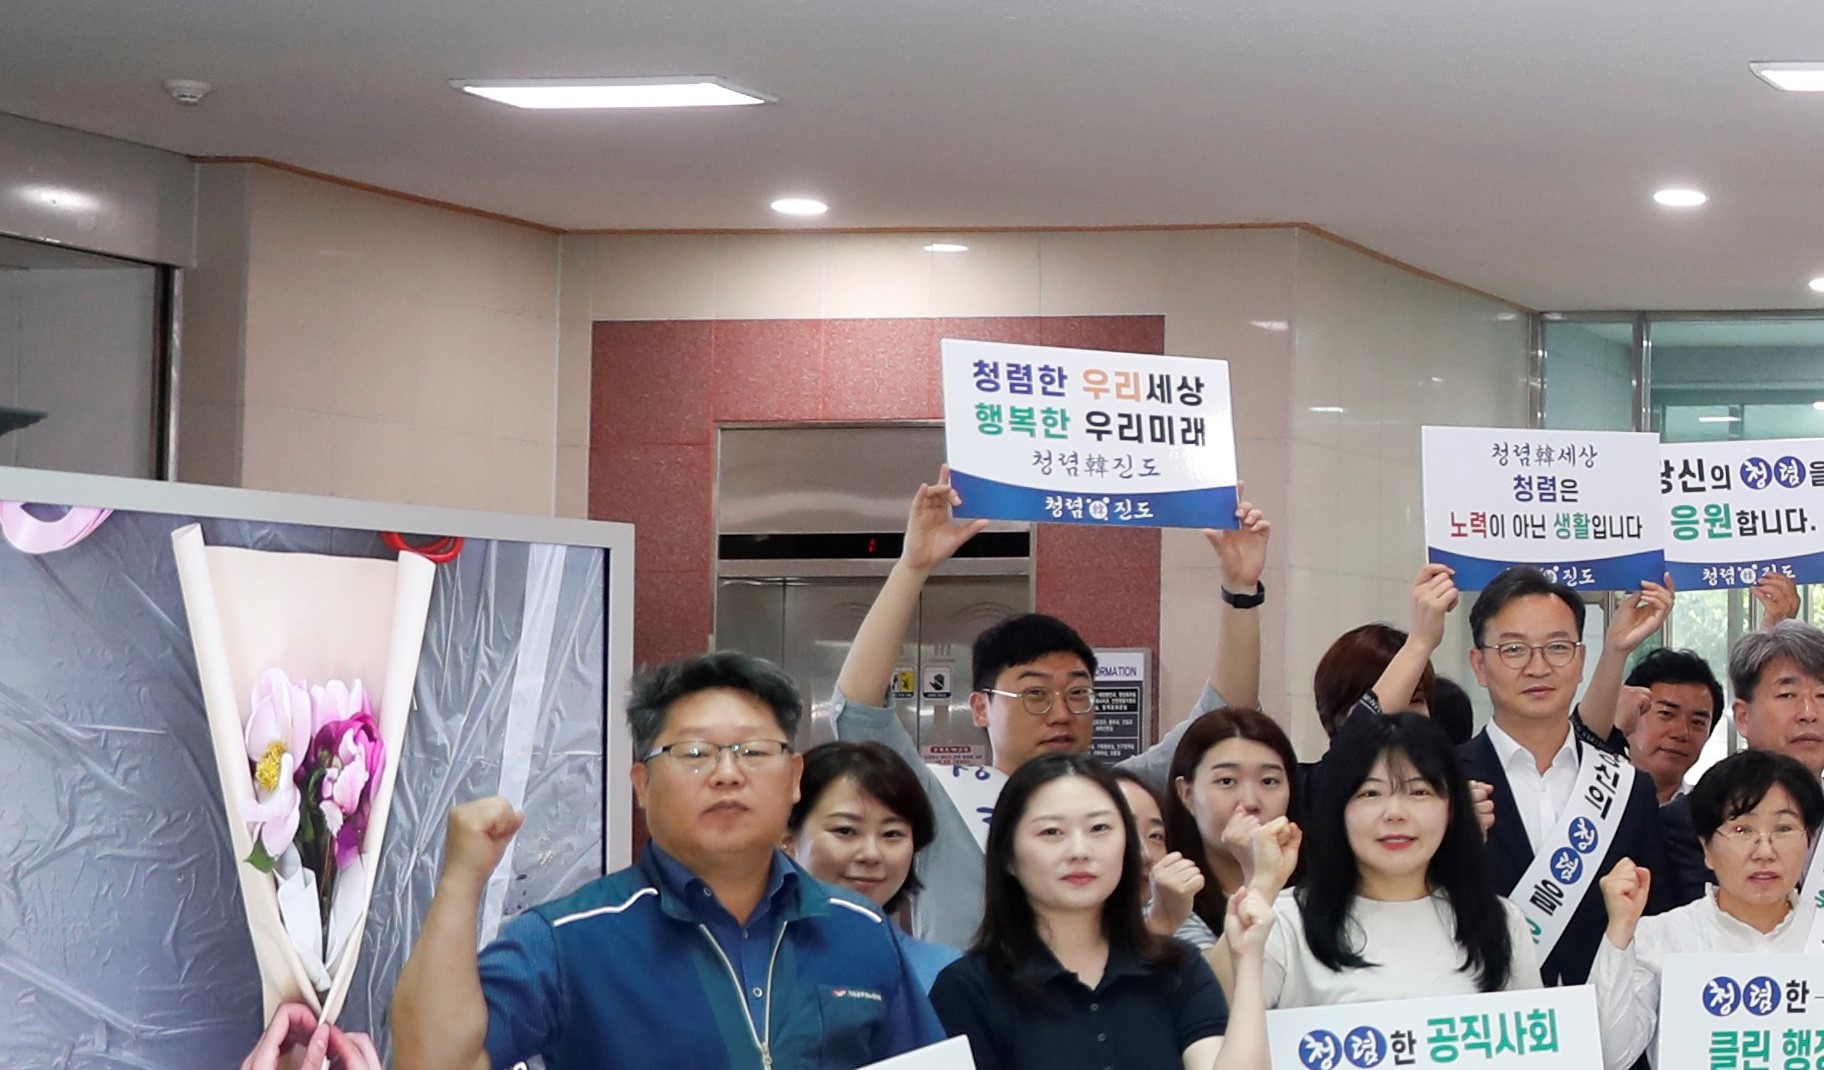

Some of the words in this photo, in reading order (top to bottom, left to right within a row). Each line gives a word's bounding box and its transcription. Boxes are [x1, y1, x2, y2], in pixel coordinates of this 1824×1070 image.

[973, 359, 1068, 397] 청렴한
[1082, 367, 1205, 407] 우리세상
[974, 402, 1070, 440] 행복한
[1085, 410, 1206, 447] 우리미래
[1512, 474, 1580, 503] 청렴은
[1450, 510, 1505, 540] 노력이
[1513, 512, 1546, 540] 아닌
[1553, 511, 1643, 541] 생활입니다
[1670, 503, 1817, 541] 응원합니다.
[1426, 1008, 1560, 1063] 공직사회
